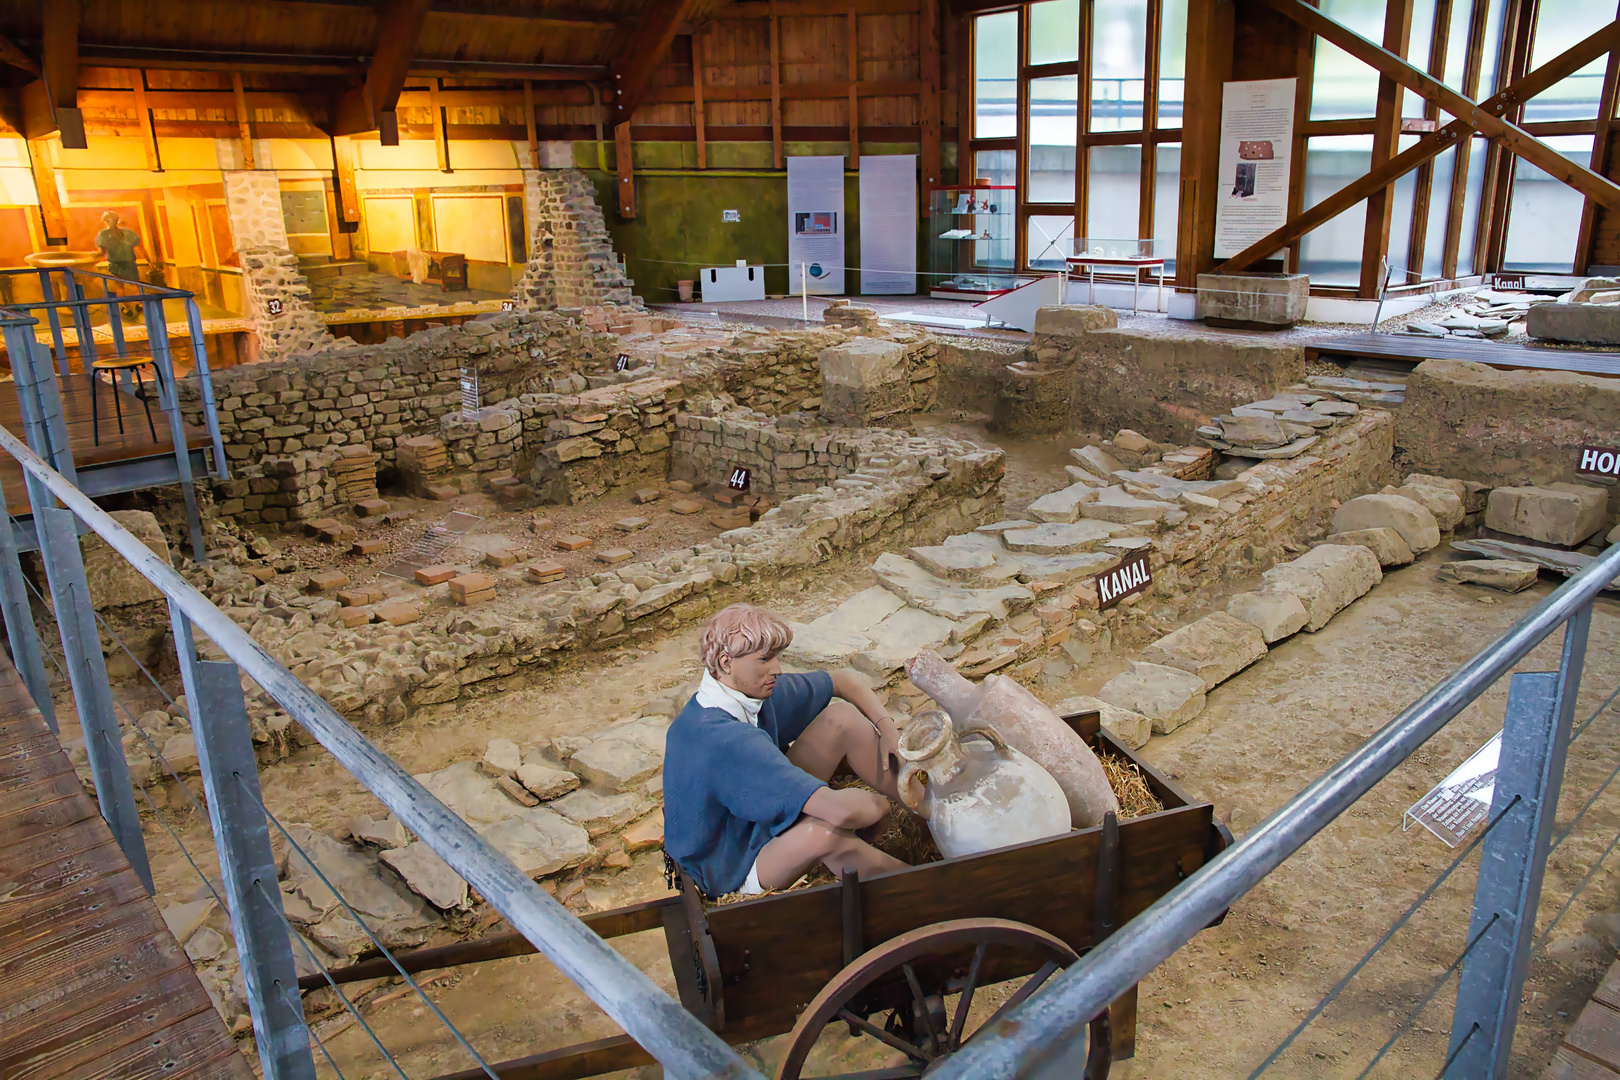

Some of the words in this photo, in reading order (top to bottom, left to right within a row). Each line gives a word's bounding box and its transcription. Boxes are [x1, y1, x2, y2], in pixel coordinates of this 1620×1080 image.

[1494, 276, 1523, 290] Kanal
[269, 300, 281, 314] 32
[616, 356, 628, 370] 41
[730, 469, 746, 488] 44
[1099, 558, 1150, 602] KANAL
